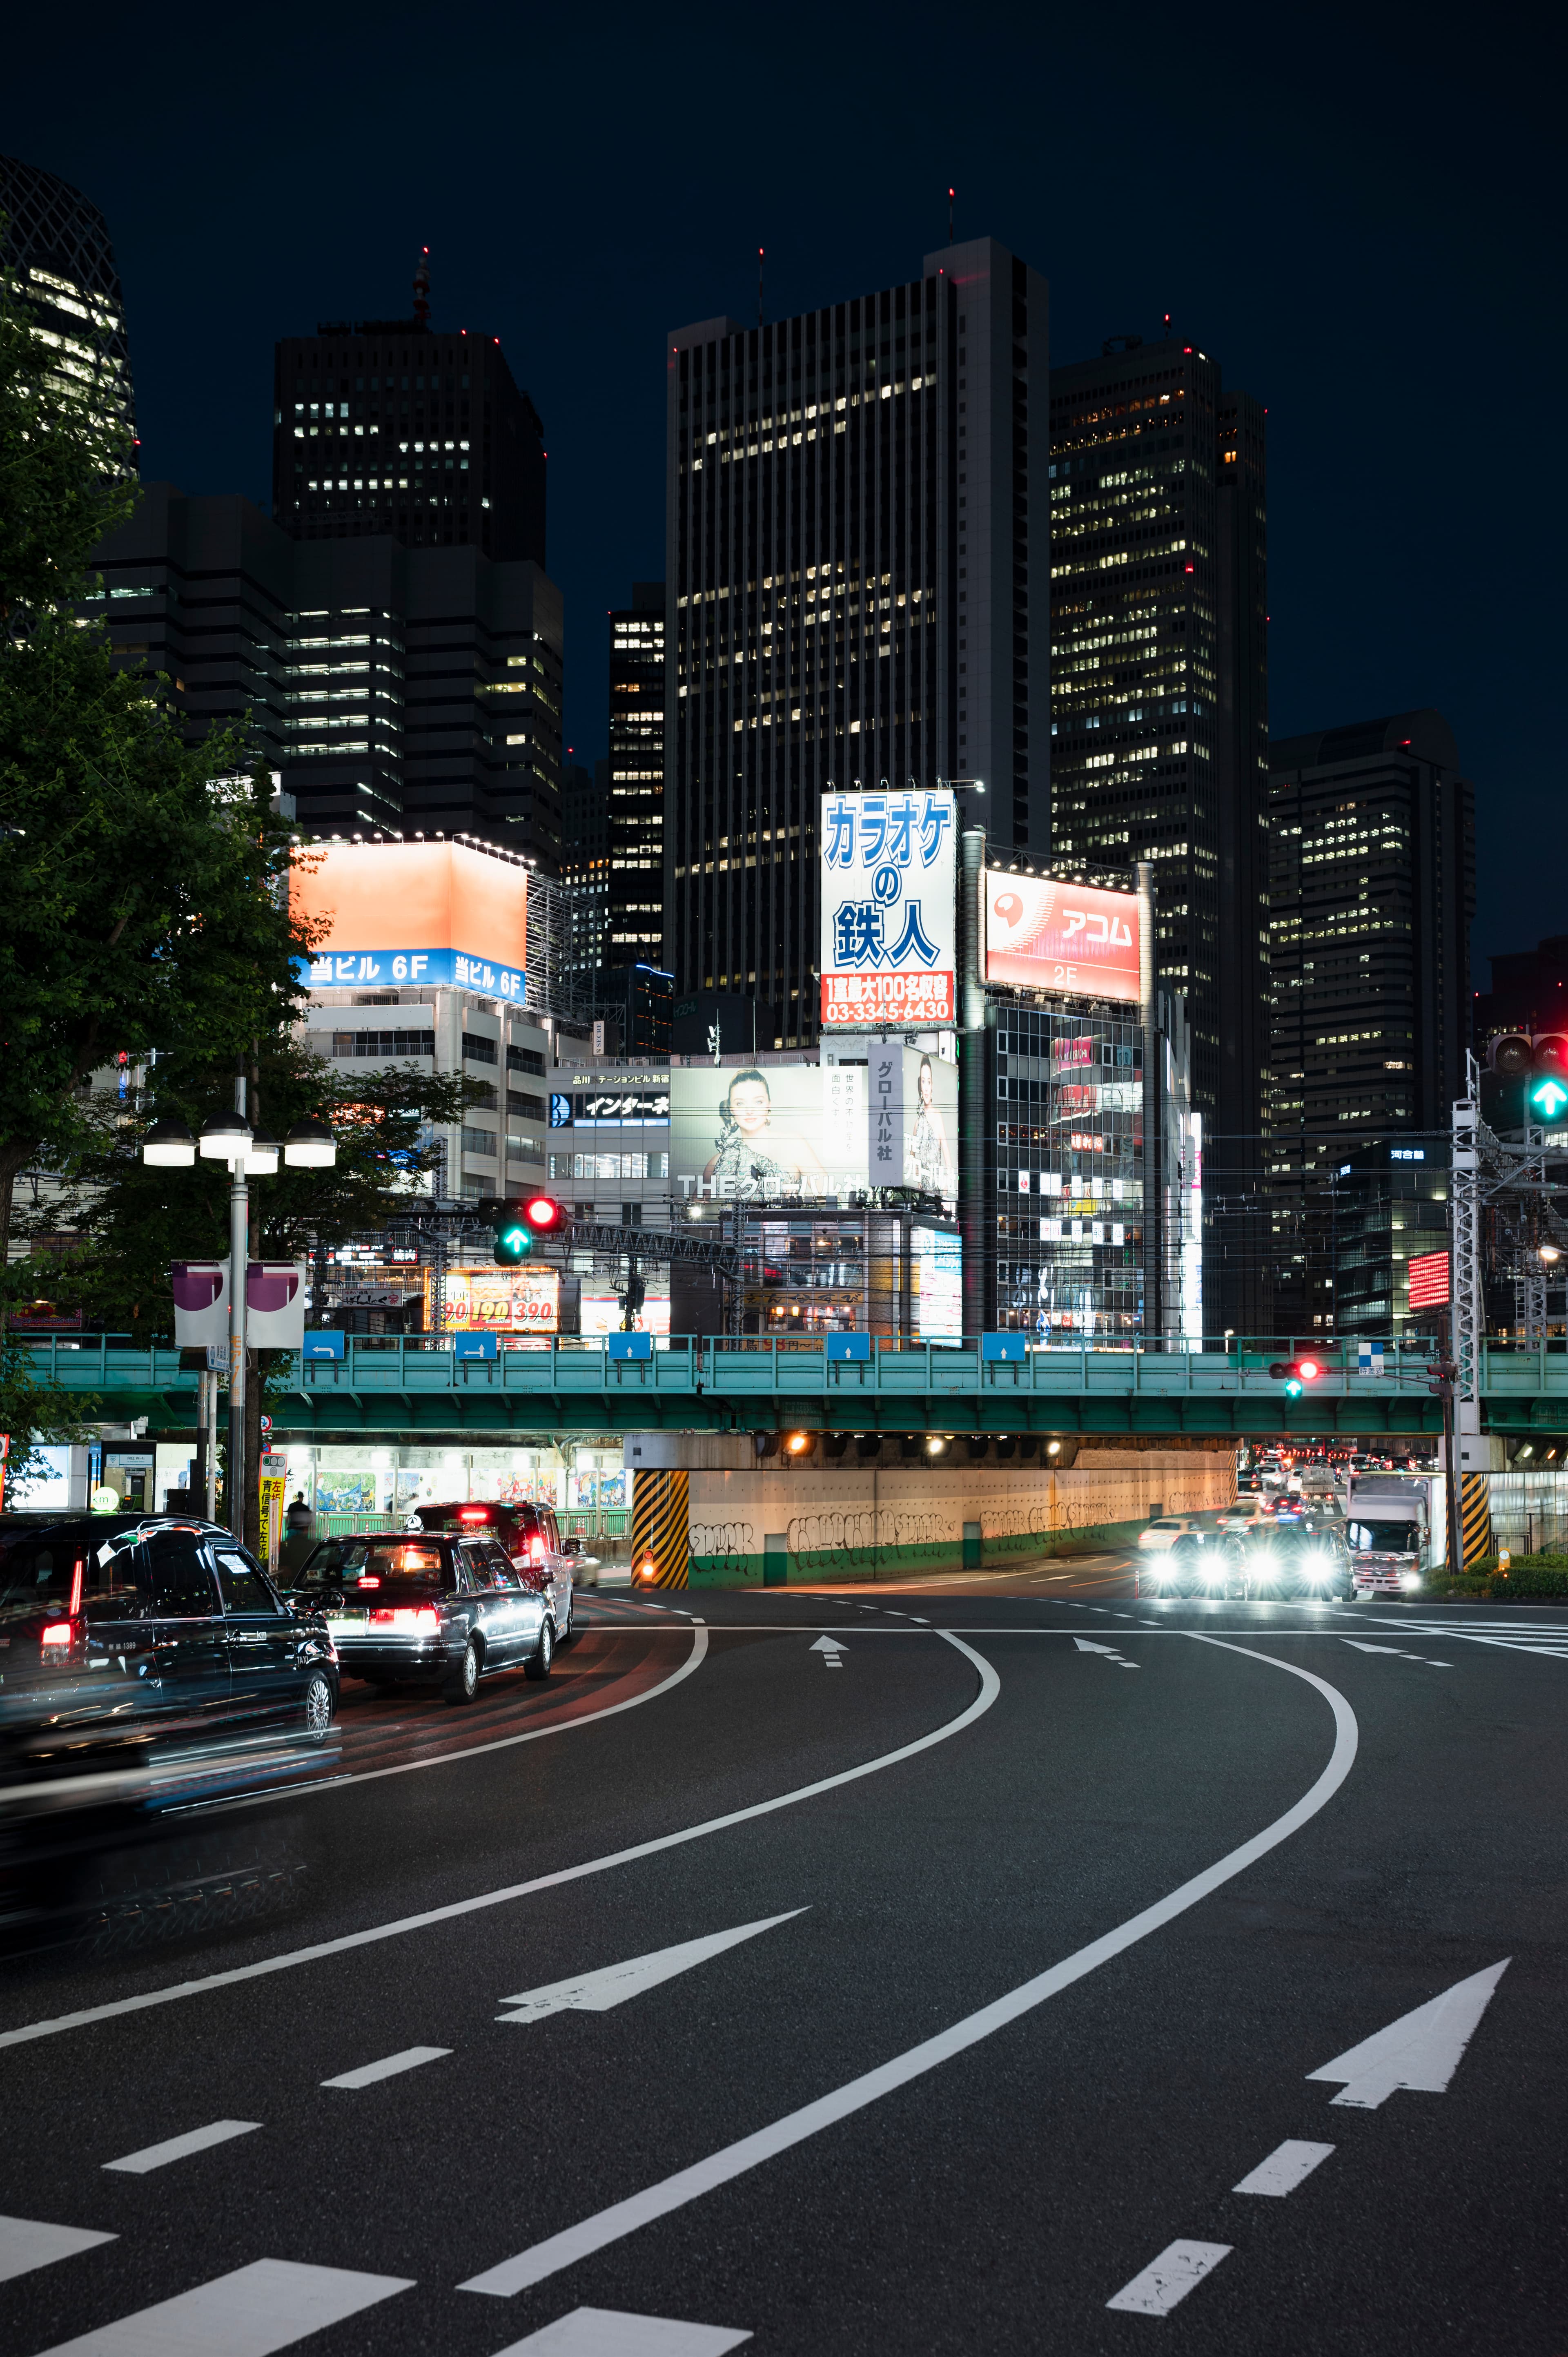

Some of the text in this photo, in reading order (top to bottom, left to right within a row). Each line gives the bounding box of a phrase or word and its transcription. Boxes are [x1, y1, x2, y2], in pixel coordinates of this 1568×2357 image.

[824, 792, 951, 870] カラオケ
[871, 861, 902, 908] の
[832, 900, 941, 969] 鉄人
[1062, 909, 1133, 947] アコム
[310, 955, 428, 981] 当ビル 6F
[455, 956, 521, 997] 当ビル 6F
[1054, 966, 1077, 986] 2F
[826, 976, 948, 1003] 1室最大100名収容
[827, 1001, 949, 1021] 03-3345-6430
[573, 1074, 670, 1085] 品川ステーションビル 新宿
[586, 1096, 670, 1115] インターネ
[877, 1061, 893, 1161] グローバル社
[1391, 1150, 1424, 1159] 河合塾
[471, 1301, 510, 1322] 190
[514, 1302, 553, 1322] 390
[1359, 1367, 1383, 1375] 時差式
[296, 1655, 309, 1664] TAXI
